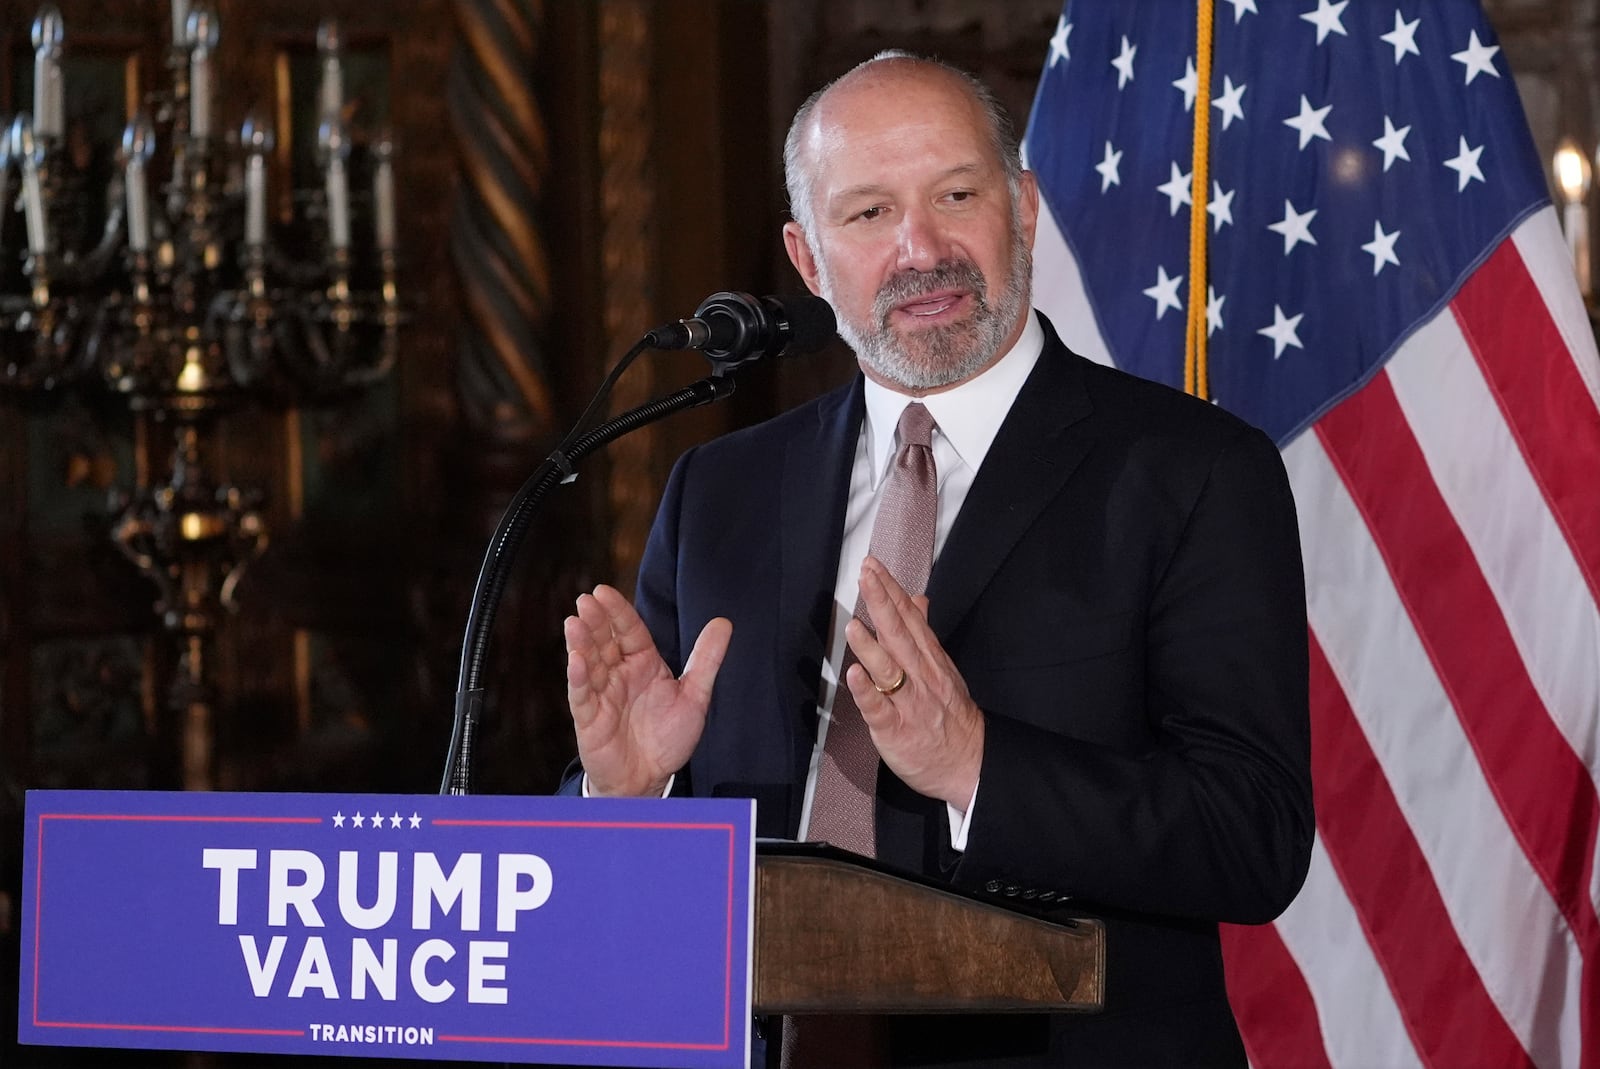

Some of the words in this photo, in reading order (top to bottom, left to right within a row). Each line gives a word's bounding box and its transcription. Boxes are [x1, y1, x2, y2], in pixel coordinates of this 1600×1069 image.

[202, 848, 553, 932] TRUMP
[238, 934, 509, 1005] VANCE
[309, 1023, 434, 1046] TRANSITION
